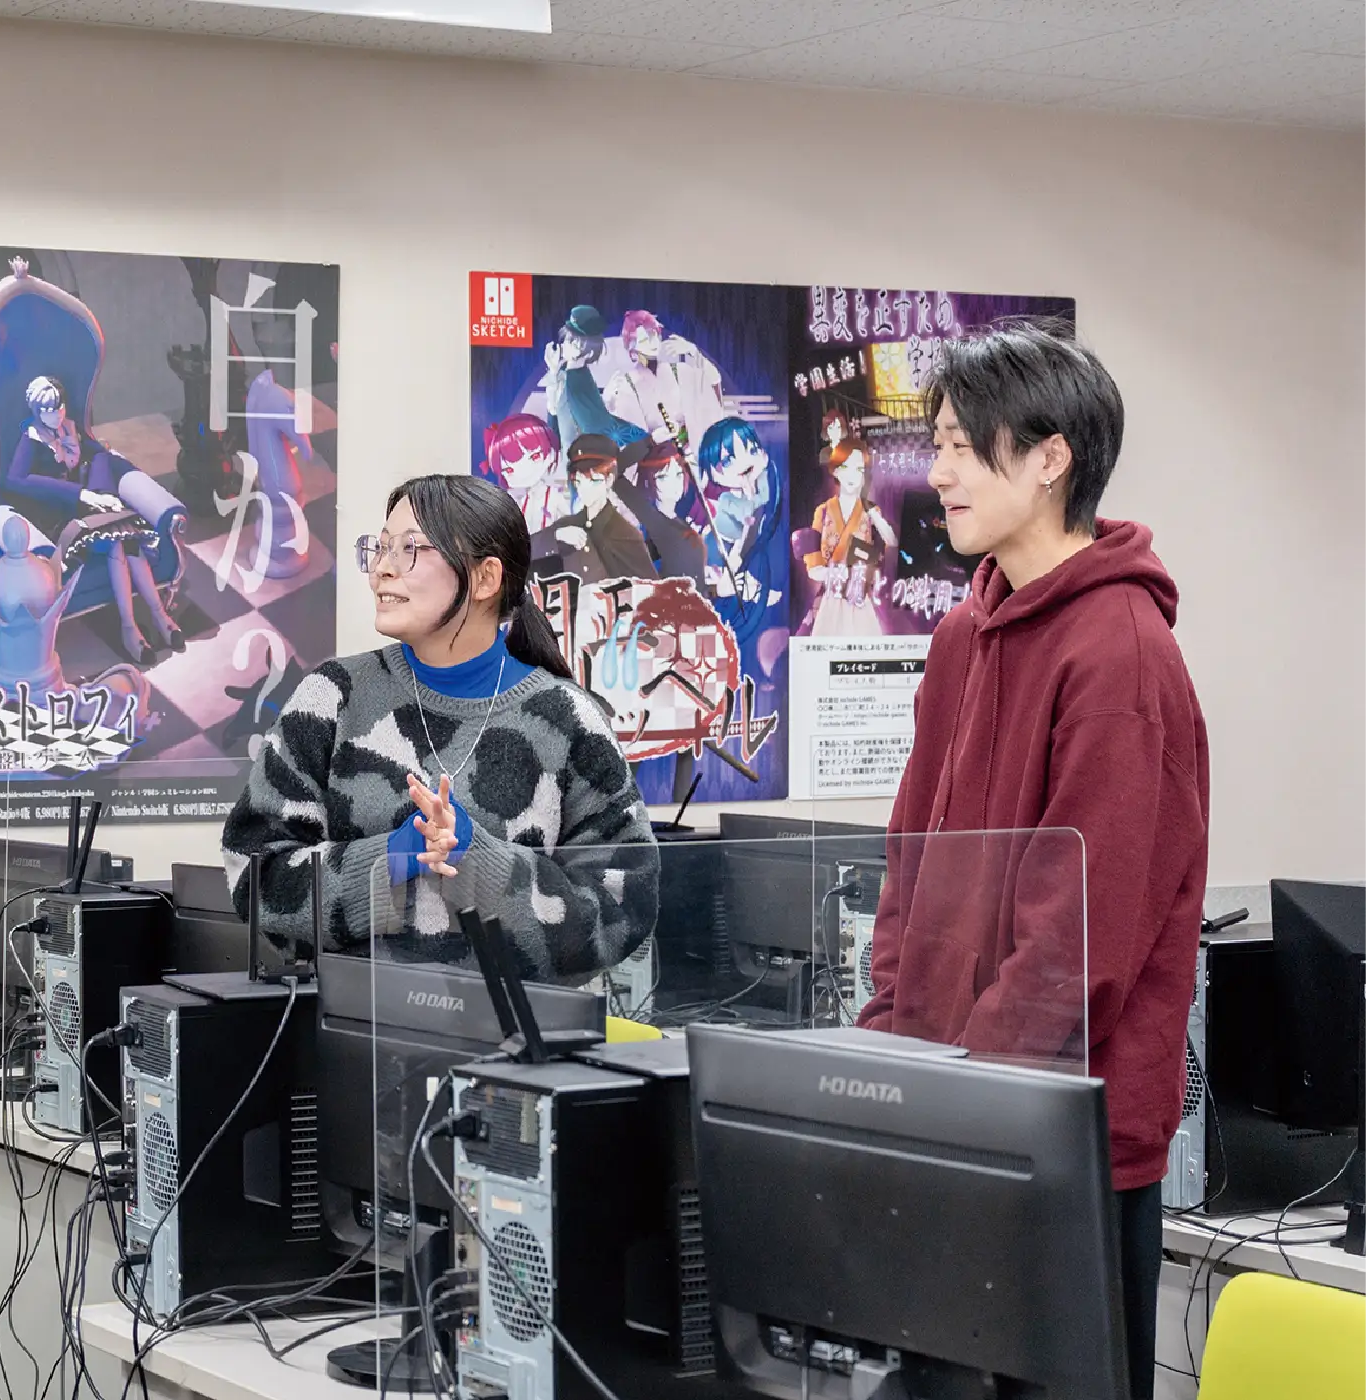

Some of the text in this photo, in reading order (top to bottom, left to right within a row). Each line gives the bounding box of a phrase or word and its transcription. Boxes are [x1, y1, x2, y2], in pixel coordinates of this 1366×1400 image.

[472, 324, 525, 338] SKETCH
[835, 661, 916, 673] プレイモード TV
